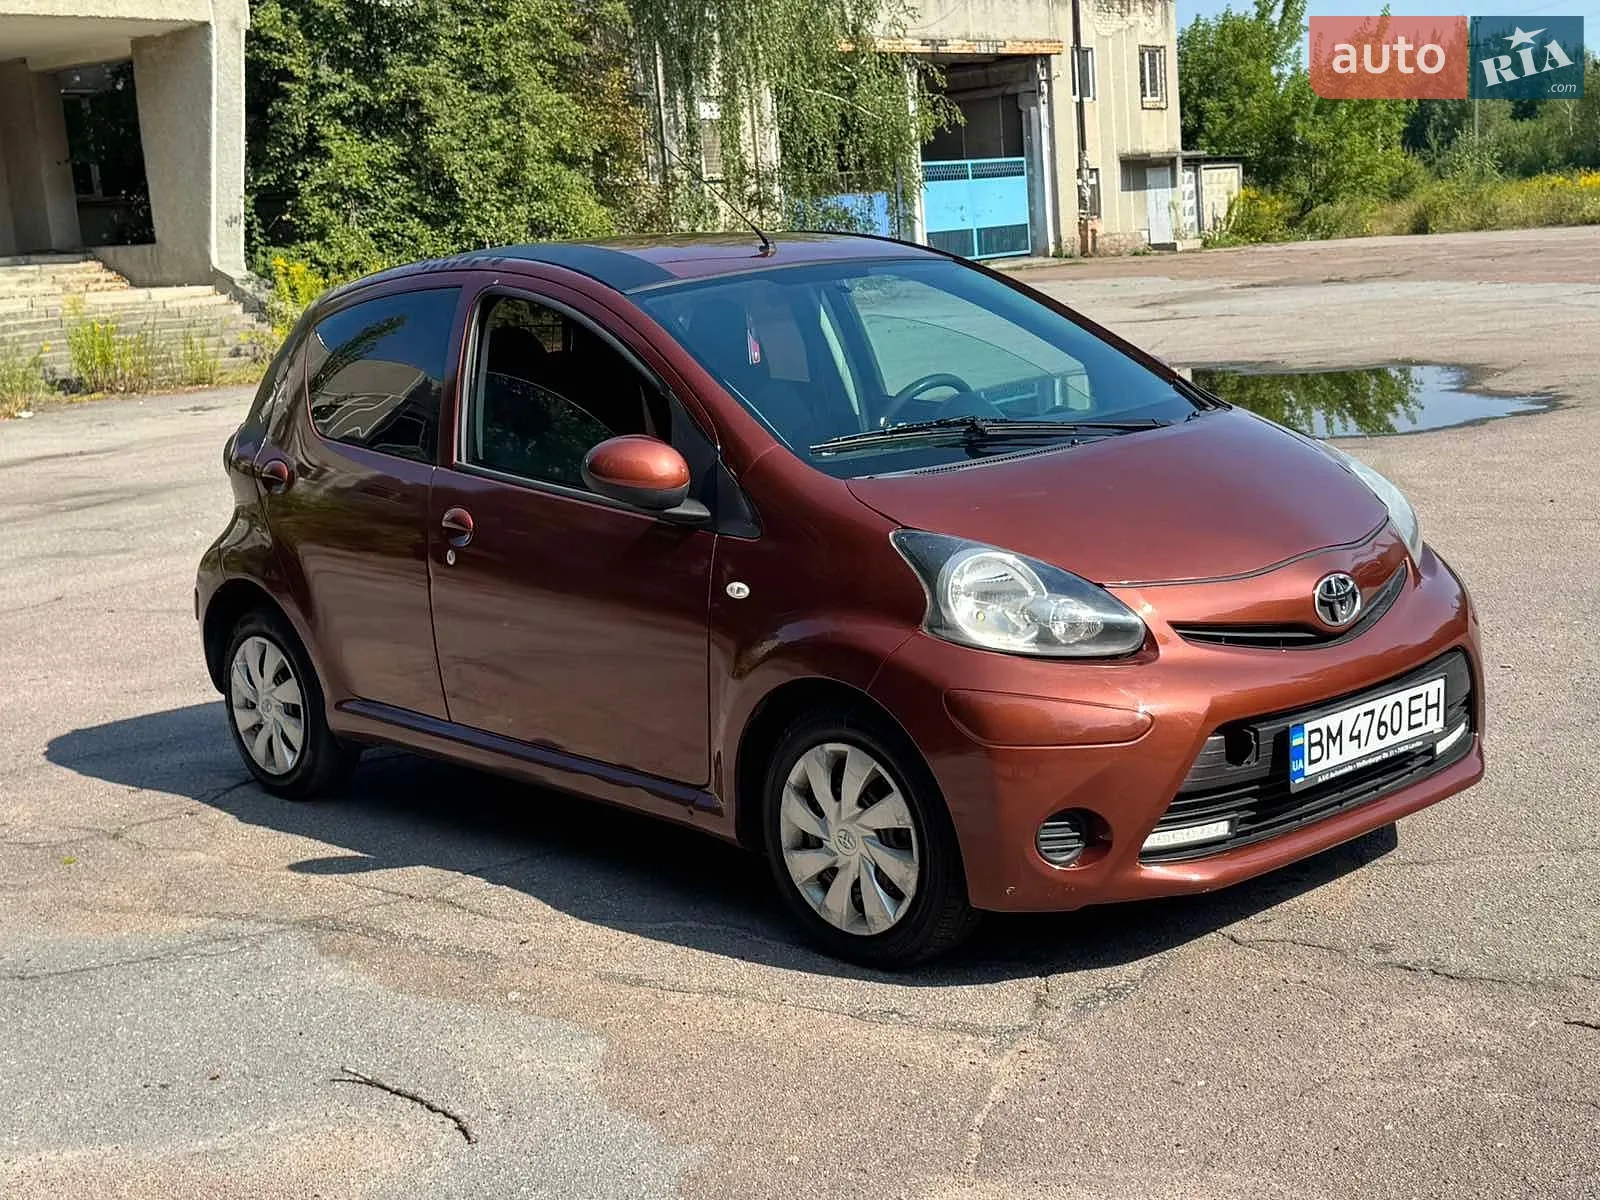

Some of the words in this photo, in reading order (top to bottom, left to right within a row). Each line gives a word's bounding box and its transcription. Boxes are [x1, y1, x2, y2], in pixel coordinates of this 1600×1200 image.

[1308, 719, 1343, 766] BM
[1349, 701, 1402, 749] 4760
[1408, 688, 1440, 731] EH
[1292, 760, 1304, 771] UA
